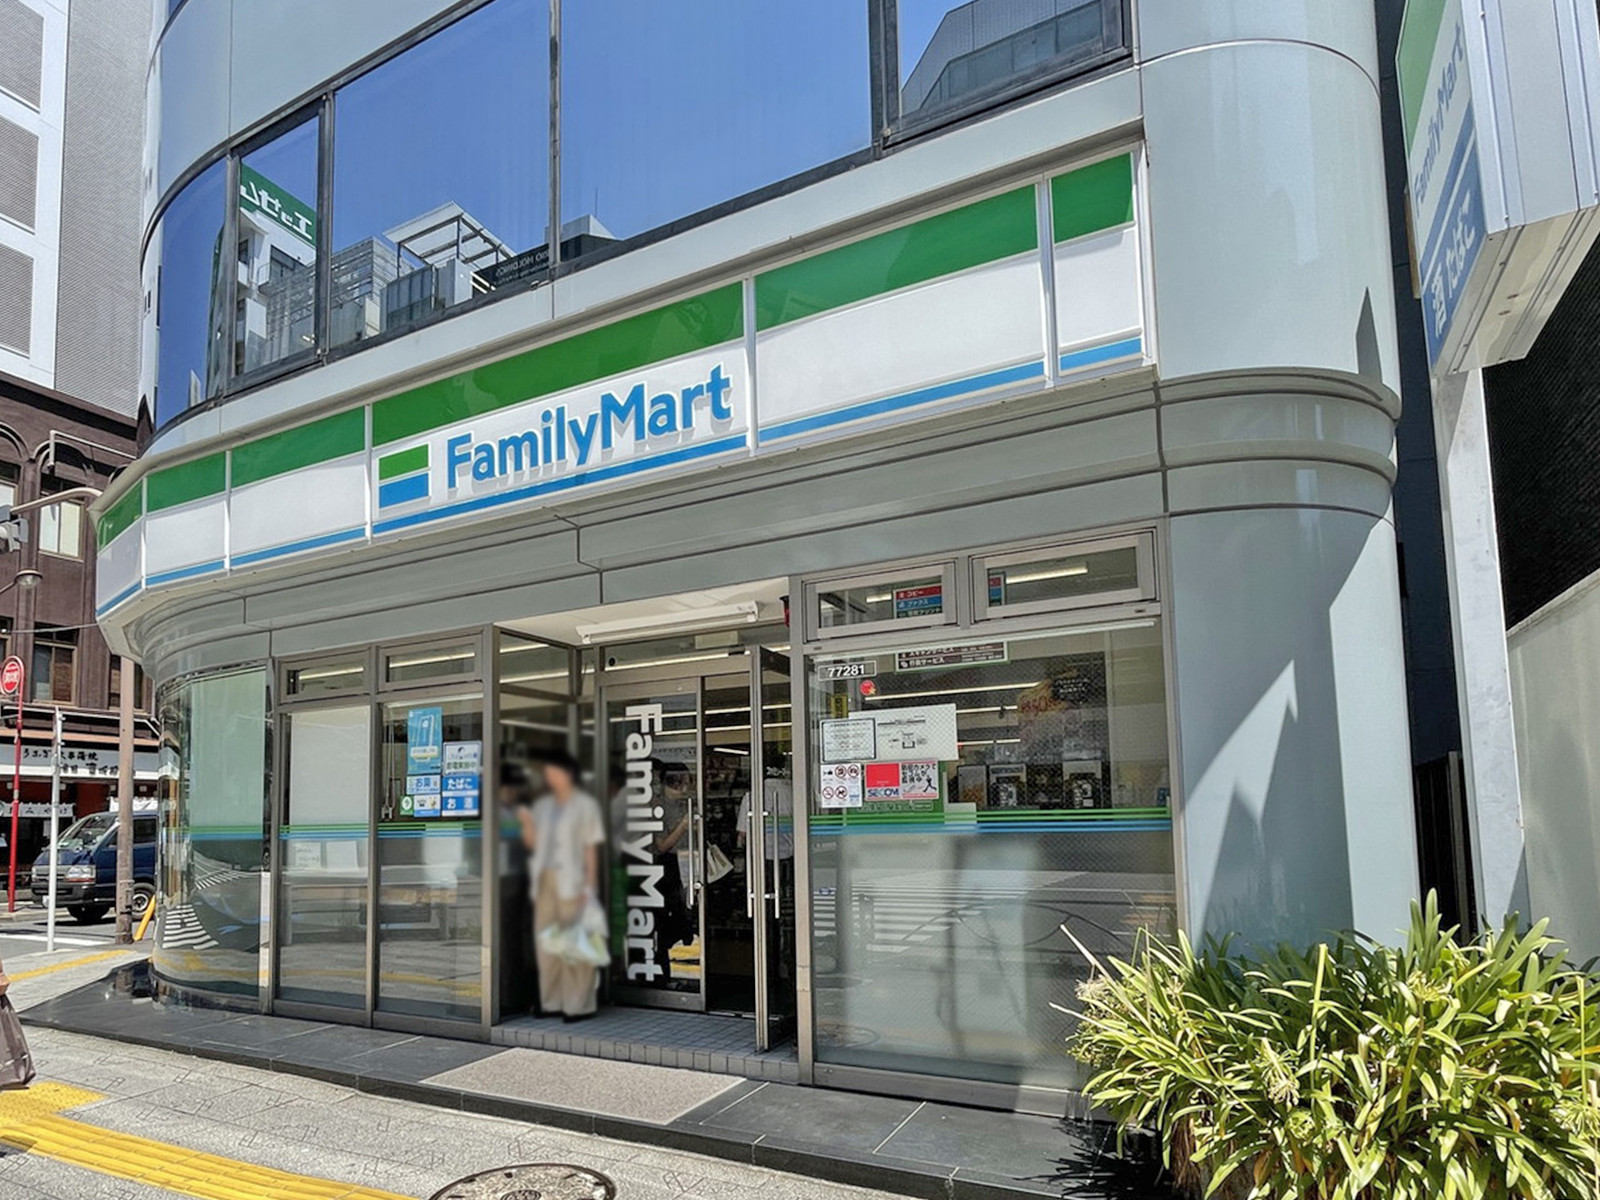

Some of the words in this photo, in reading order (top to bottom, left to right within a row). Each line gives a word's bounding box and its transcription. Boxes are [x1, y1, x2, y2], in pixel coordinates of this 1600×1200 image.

[1413, 21, 1463, 220] FamilyMart
[1431, 261, 1447, 339] 酒
[1446, 188, 1475, 300] たばこ
[446, 363, 732, 490] FamilyMart
[827, 664, 865, 678] 77281
[447, 777, 473, 790] たばこ
[620, 702, 665, 982] FamilyMart
[867, 788, 900, 798] SECOM
